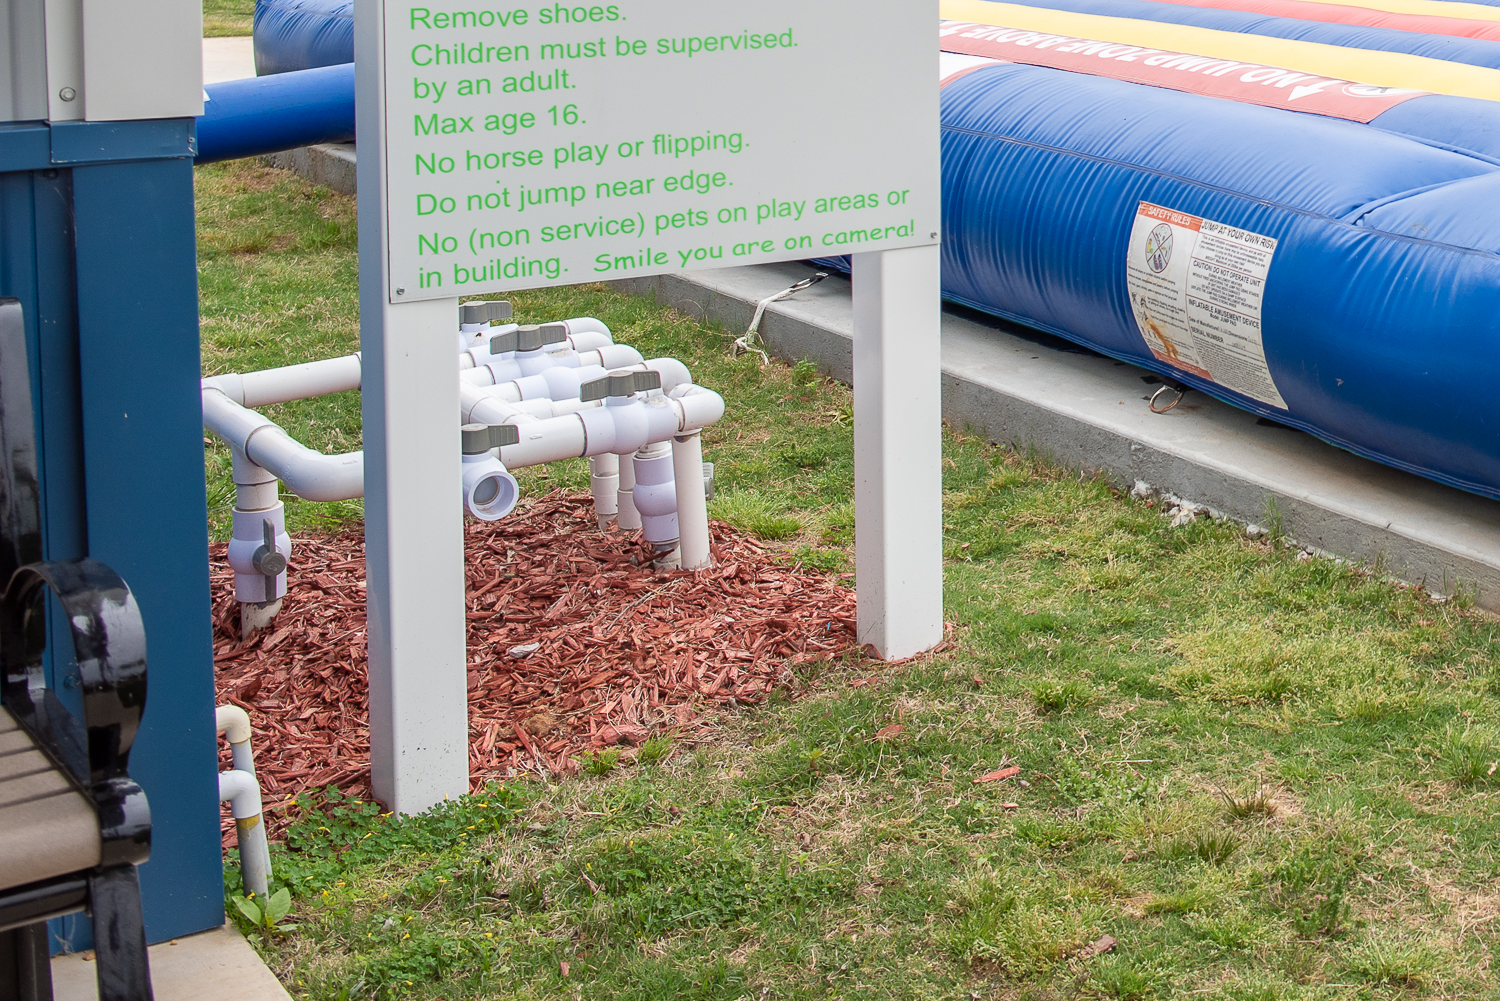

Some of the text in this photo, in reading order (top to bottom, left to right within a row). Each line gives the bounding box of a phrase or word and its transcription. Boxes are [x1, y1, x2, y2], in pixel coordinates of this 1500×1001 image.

[409, 1, 627, 31] Remove shoes.
[410, 26, 799, 67] Children must be supervised.
[959, 25, 1319, 88] NO JUMP ZONE ABOVE
[413, 67, 577, 104] by an adult.
[413, 103, 587, 137] Max age 16.
[414, 129, 750, 176] No horse play or flipping.
[415, 168, 734, 217] Do not jump near edge.
[417, 188, 911, 260] No (non service) pets on play areas or
[1147, 206, 1192, 226] SAFETY RULES
[1201, 220, 1218, 234] JUMP
[1217, 225, 1228, 236] AT
[1227, 228, 1245, 240] YOUR
[1244, 233, 1260, 245] OWN
[418, 218, 915, 289] in building. Smile you are on camera!
